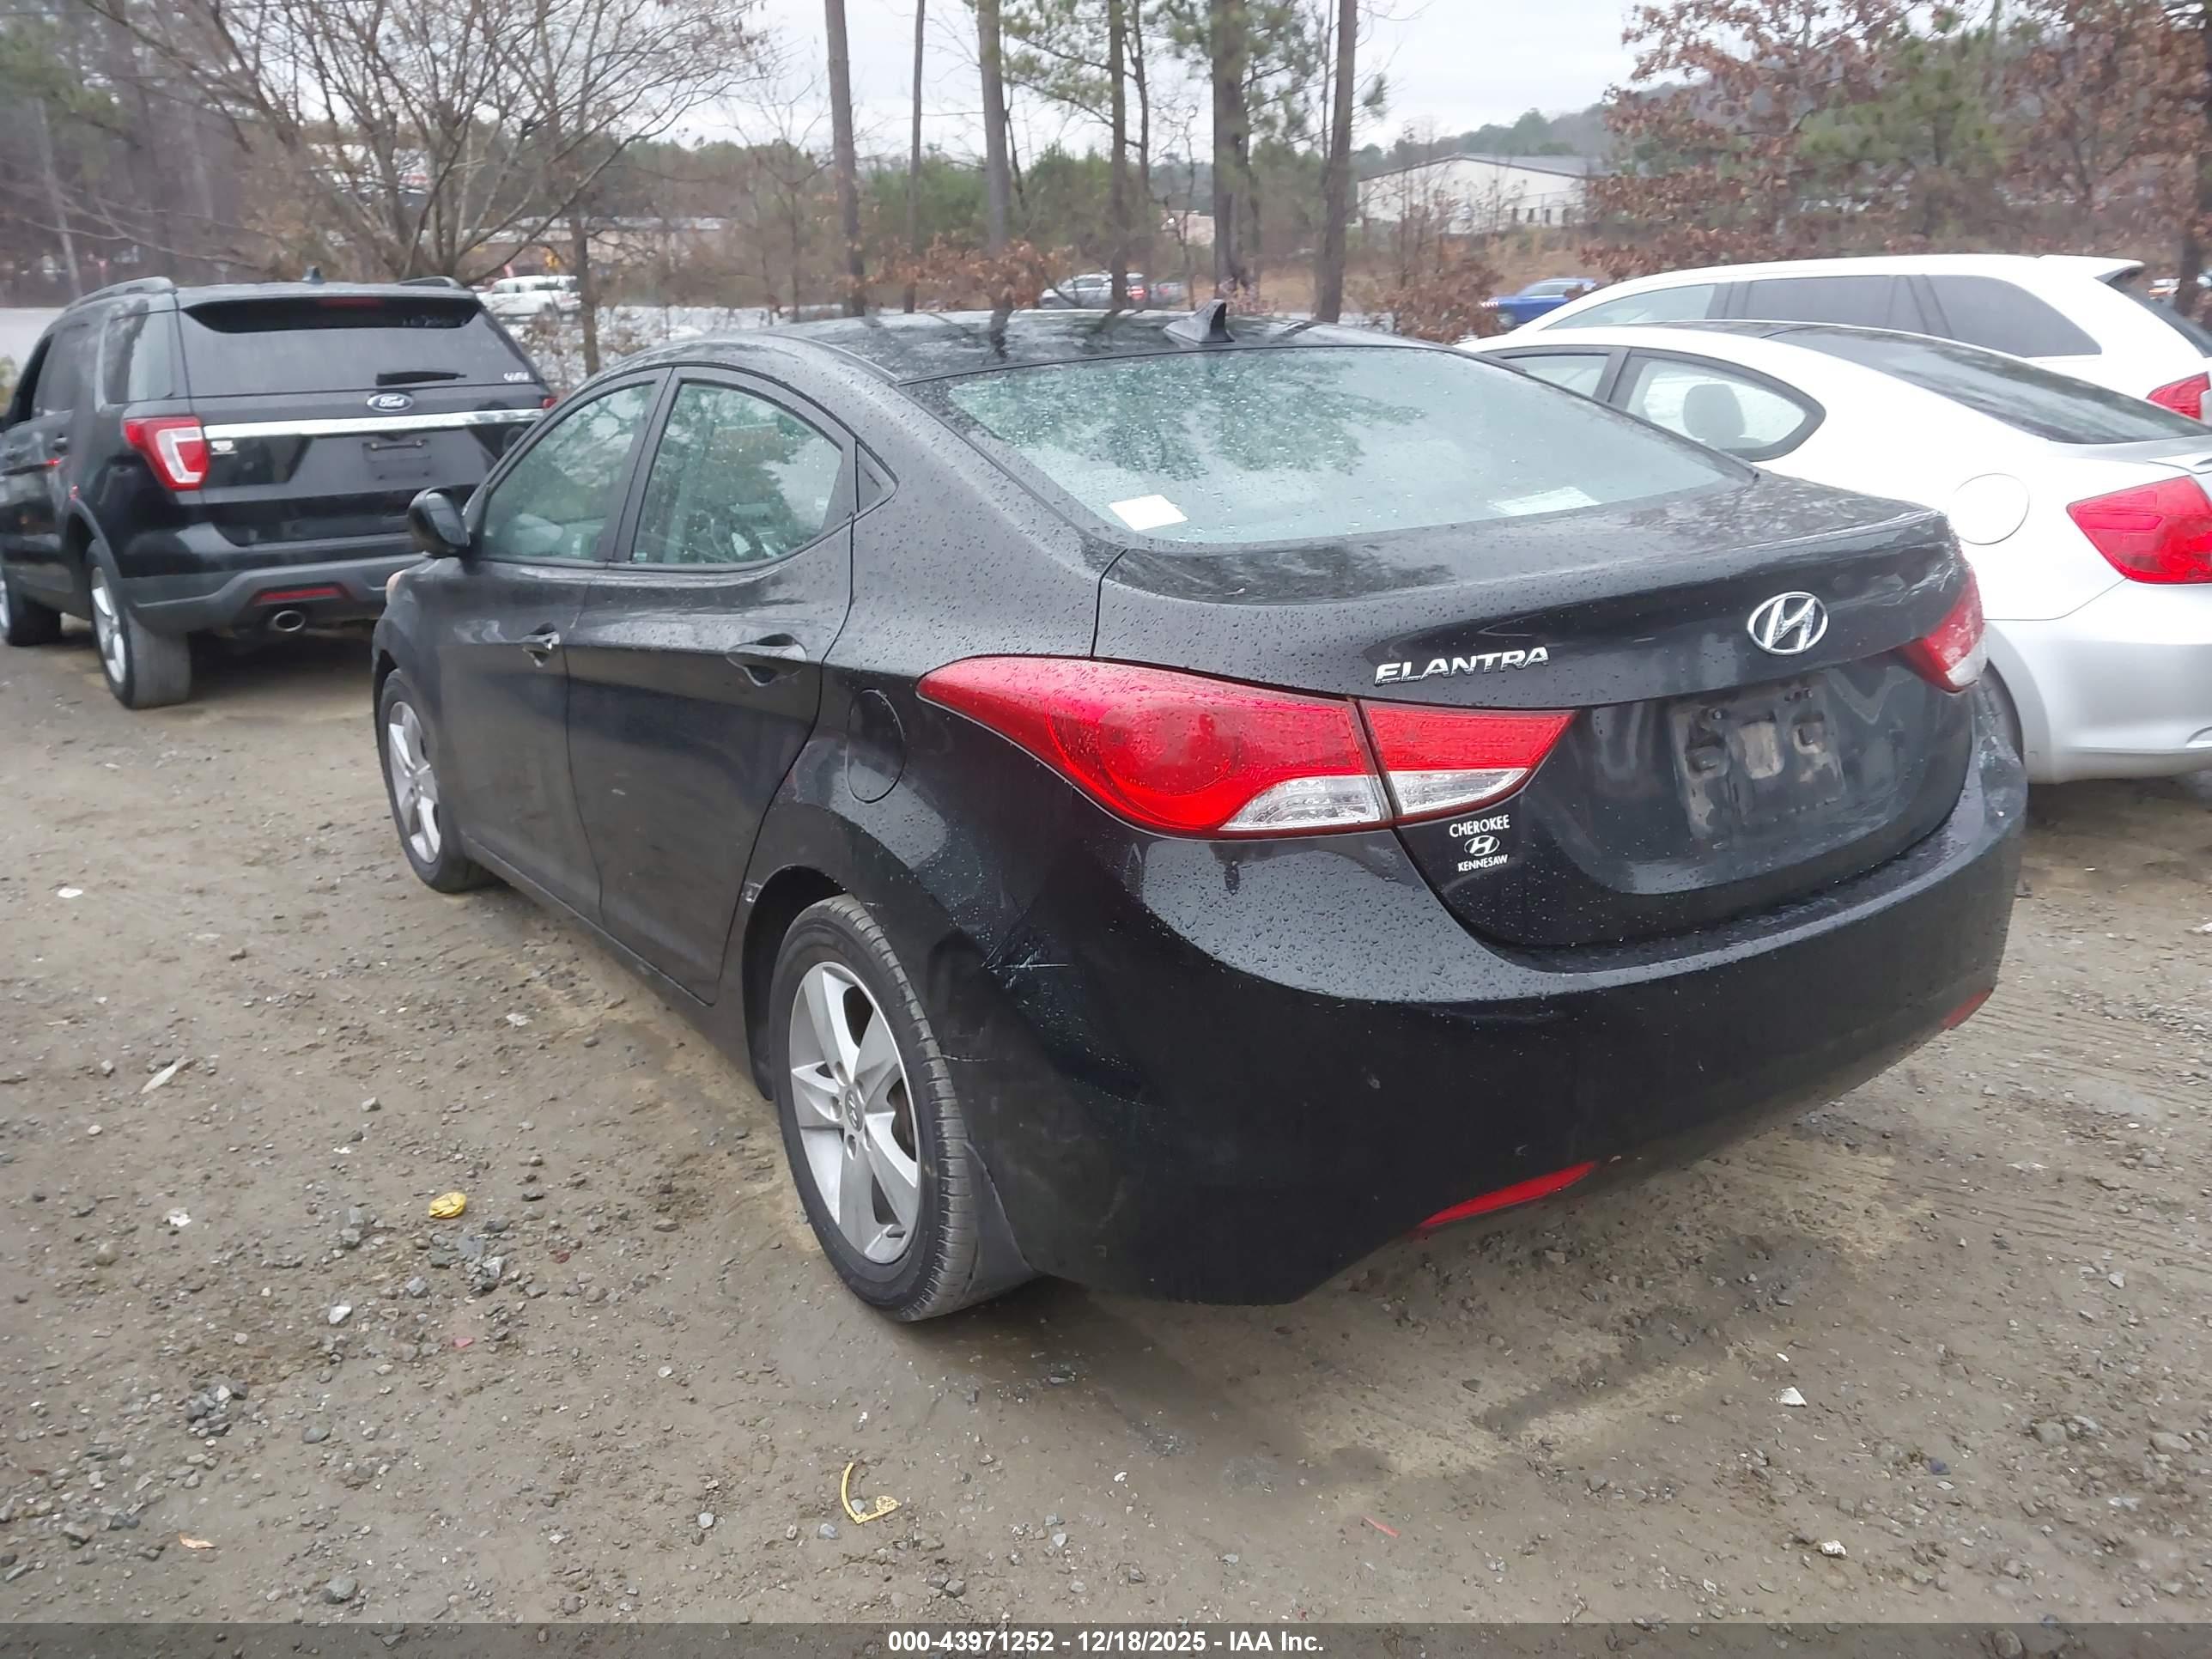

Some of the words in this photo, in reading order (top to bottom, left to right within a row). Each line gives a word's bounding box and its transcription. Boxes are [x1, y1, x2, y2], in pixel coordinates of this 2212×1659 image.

[1375, 647, 1548, 686] ELANTRA
[1449, 814, 1510, 837] CHEROKEE
[1457, 854, 1508, 872] KENNESAW
